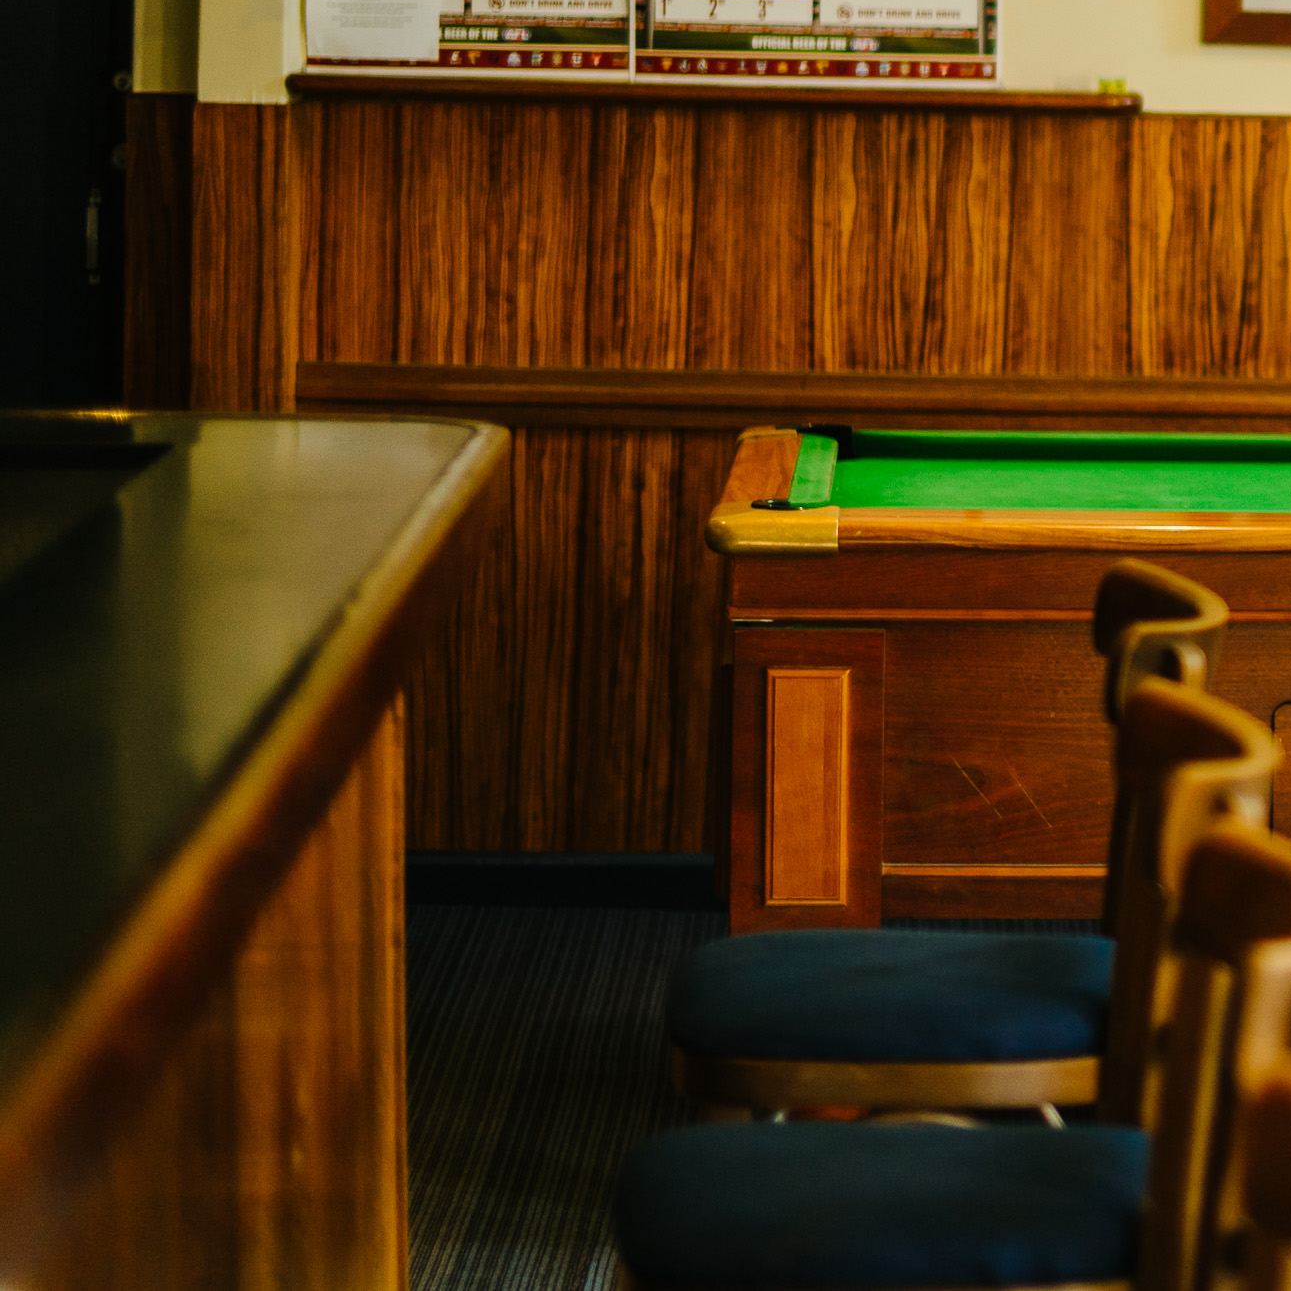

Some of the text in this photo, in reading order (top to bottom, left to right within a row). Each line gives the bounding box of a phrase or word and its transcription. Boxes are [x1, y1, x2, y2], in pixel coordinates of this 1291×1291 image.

[444, 27, 467, 41] BEER
[468, 27, 481, 41] OF
[482, 27, 499, 41] THE
[504, 28, 530, 42] AFL
[751, 35, 791, 50] OFFICIAL
[792, 36, 816, 51] BEER
[817, 37, 829, 51] OF
[830, 37, 847, 51] THE
